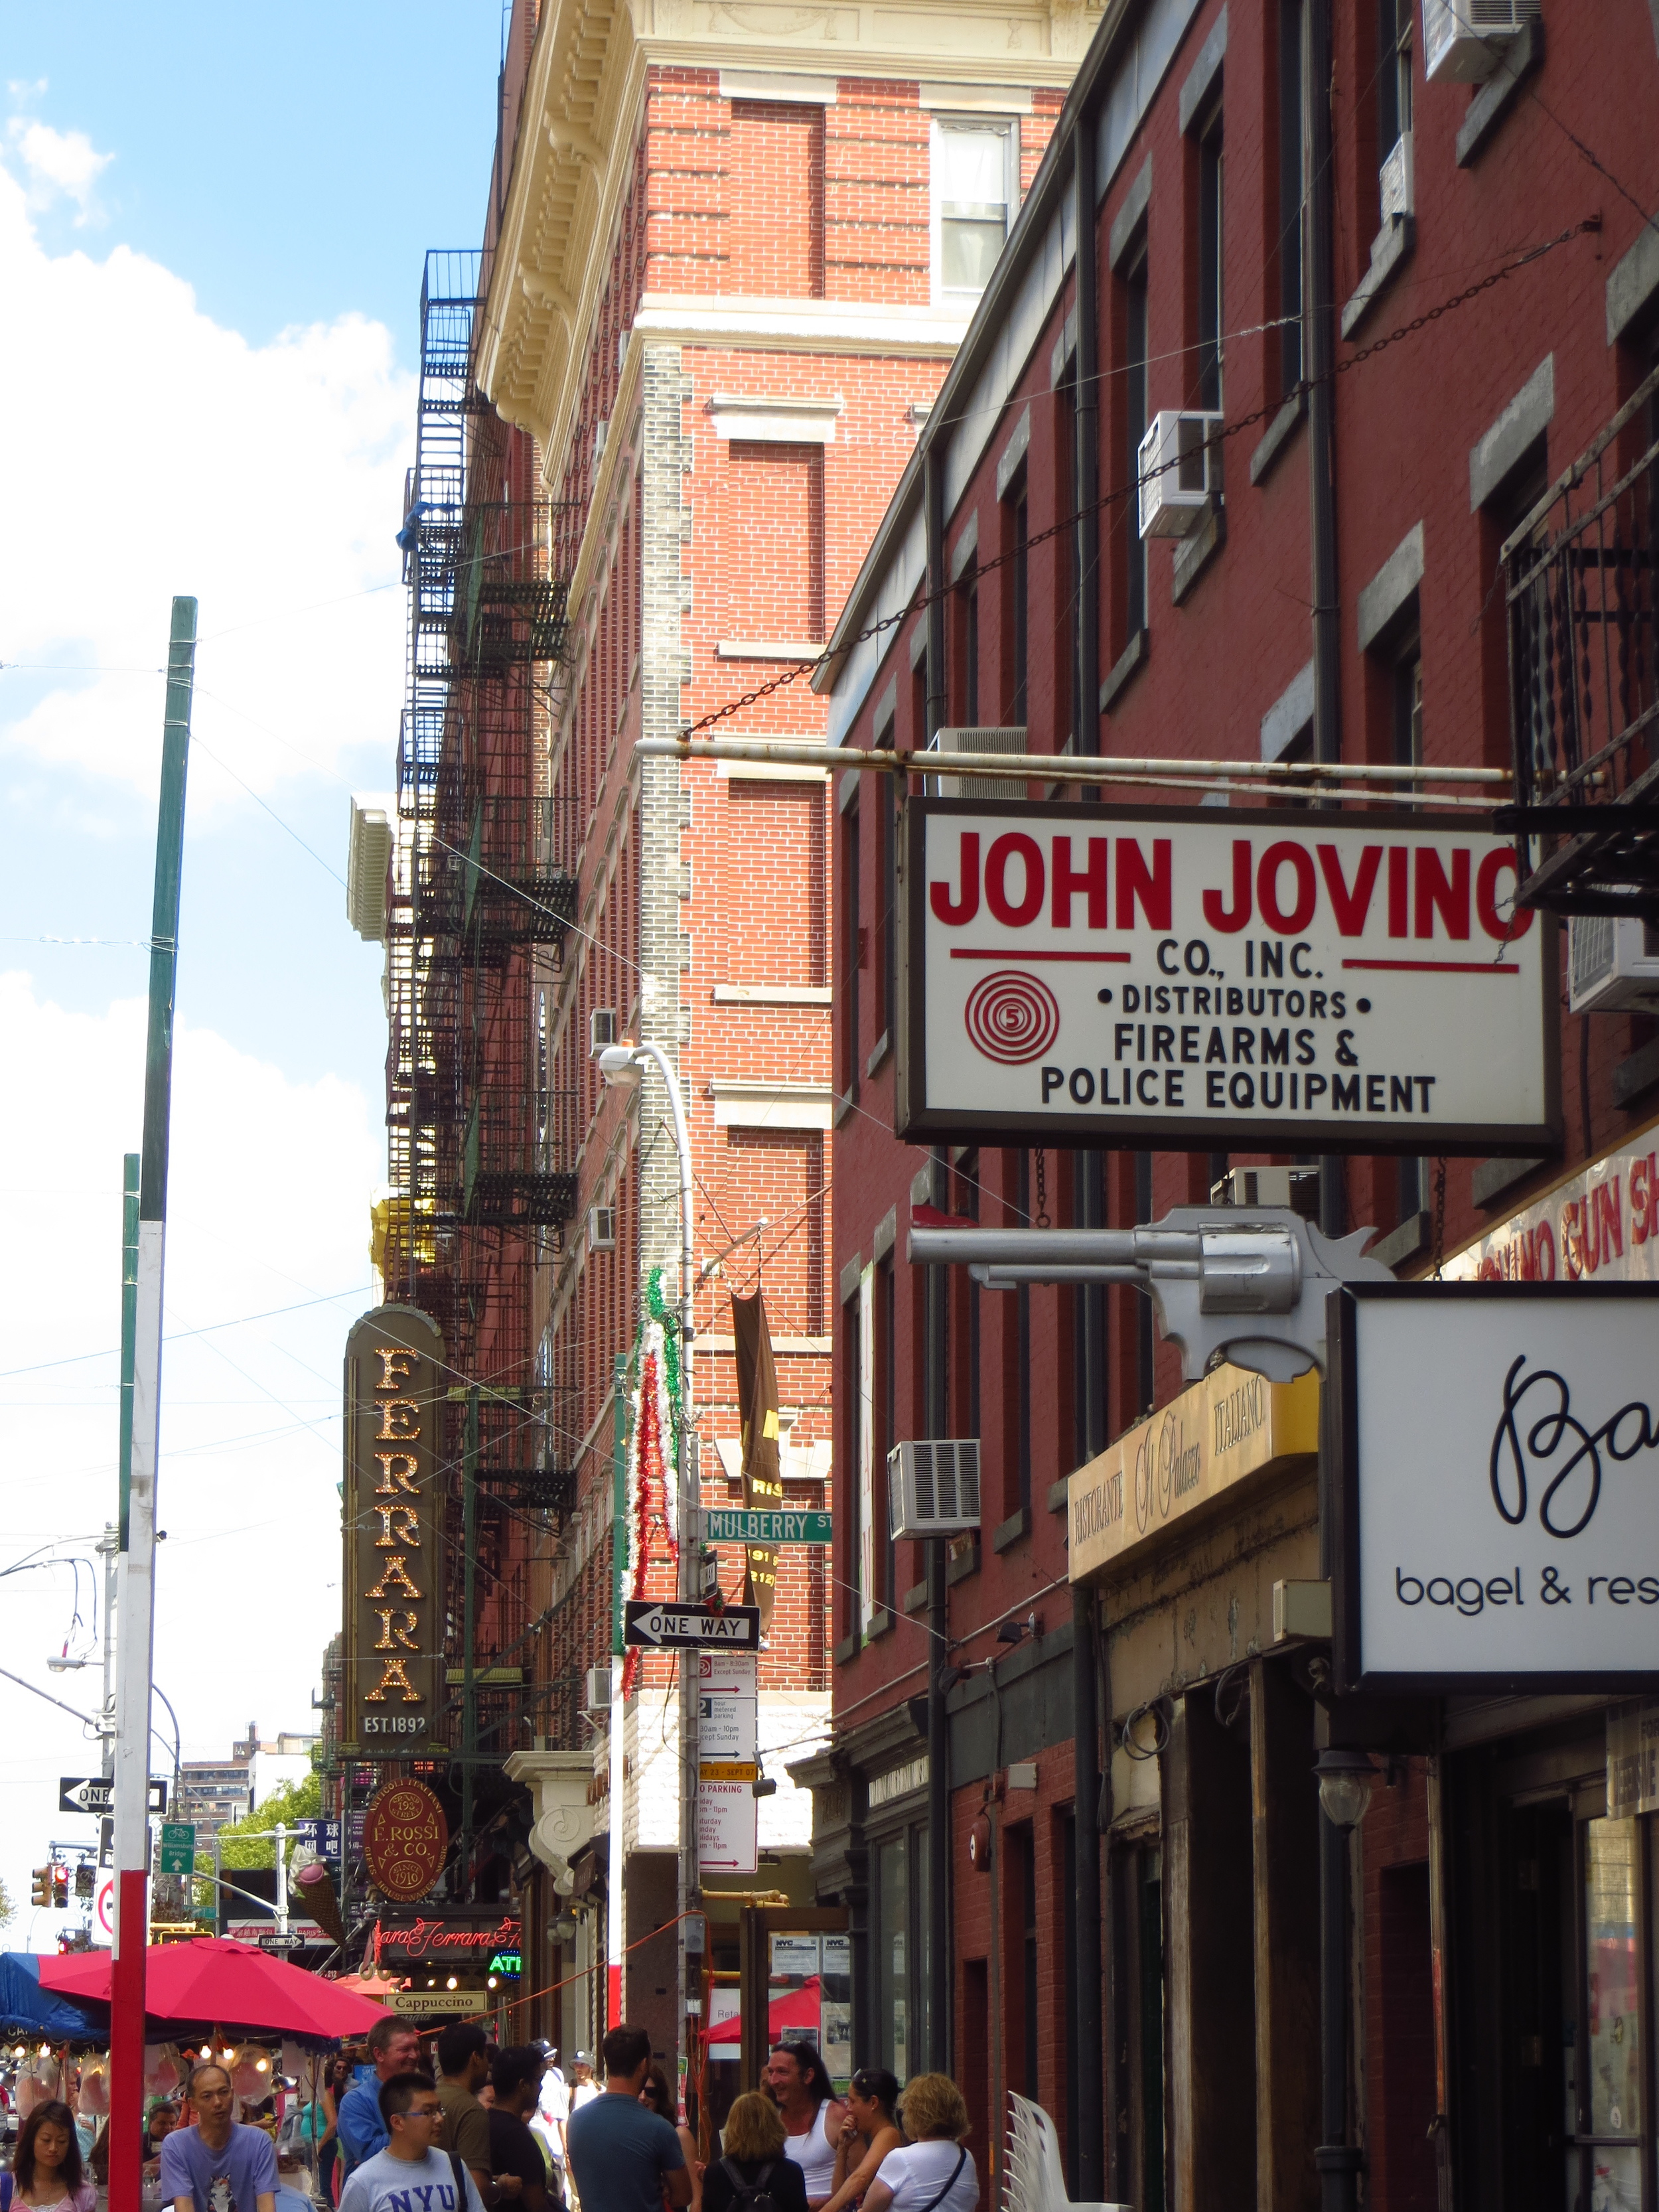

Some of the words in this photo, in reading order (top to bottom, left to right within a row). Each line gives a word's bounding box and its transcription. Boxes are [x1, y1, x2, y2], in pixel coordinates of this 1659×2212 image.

[930, 832, 1173, 930] JOHN
[1202, 839, 1536, 941] JOVINO
[1156, 938, 1225, 981] CO.,
[1245, 940, 1324, 980] INC.
[1122, 984, 1346, 1019] DISTRIBUTORS
[1115, 1023, 1316, 1065] FIREARMS
[1336, 1031, 1359, 1066] &
[1042, 1067, 1184, 1107] POLICE
[1206, 1070, 1435, 1113] EQUIPMENT
[1561, 1175, 1623, 1281] GUN
[1214, 1374, 1263, 1457] ITALIANO
[364, 1348, 425, 1702] FERRARA
[1074, 1470, 1124, 1546] RISTORANTE
[710, 1514, 808, 1539] MULBERRY
[1396, 1566, 1524, 1617] bagel
[1540, 1566, 1572, 1606] &
[1589, 1576, 1659, 1606] res
[650, 1616, 689, 1635] ONE
[701, 1619, 742, 1636] WAY
[392, 1807, 420, 1818] STREET
[393, 1794, 421, 1805] GRAND
[163, 1842, 194, 1850] Williamsburg
[384, 1842, 399, 1857] &
[403, 1842, 431, 1856] CO.
[395, 1872, 419, 1886] 1910
[396, 1996, 473, 2010] Cappuccino
[388, 2184, 456, 2212] NYU
